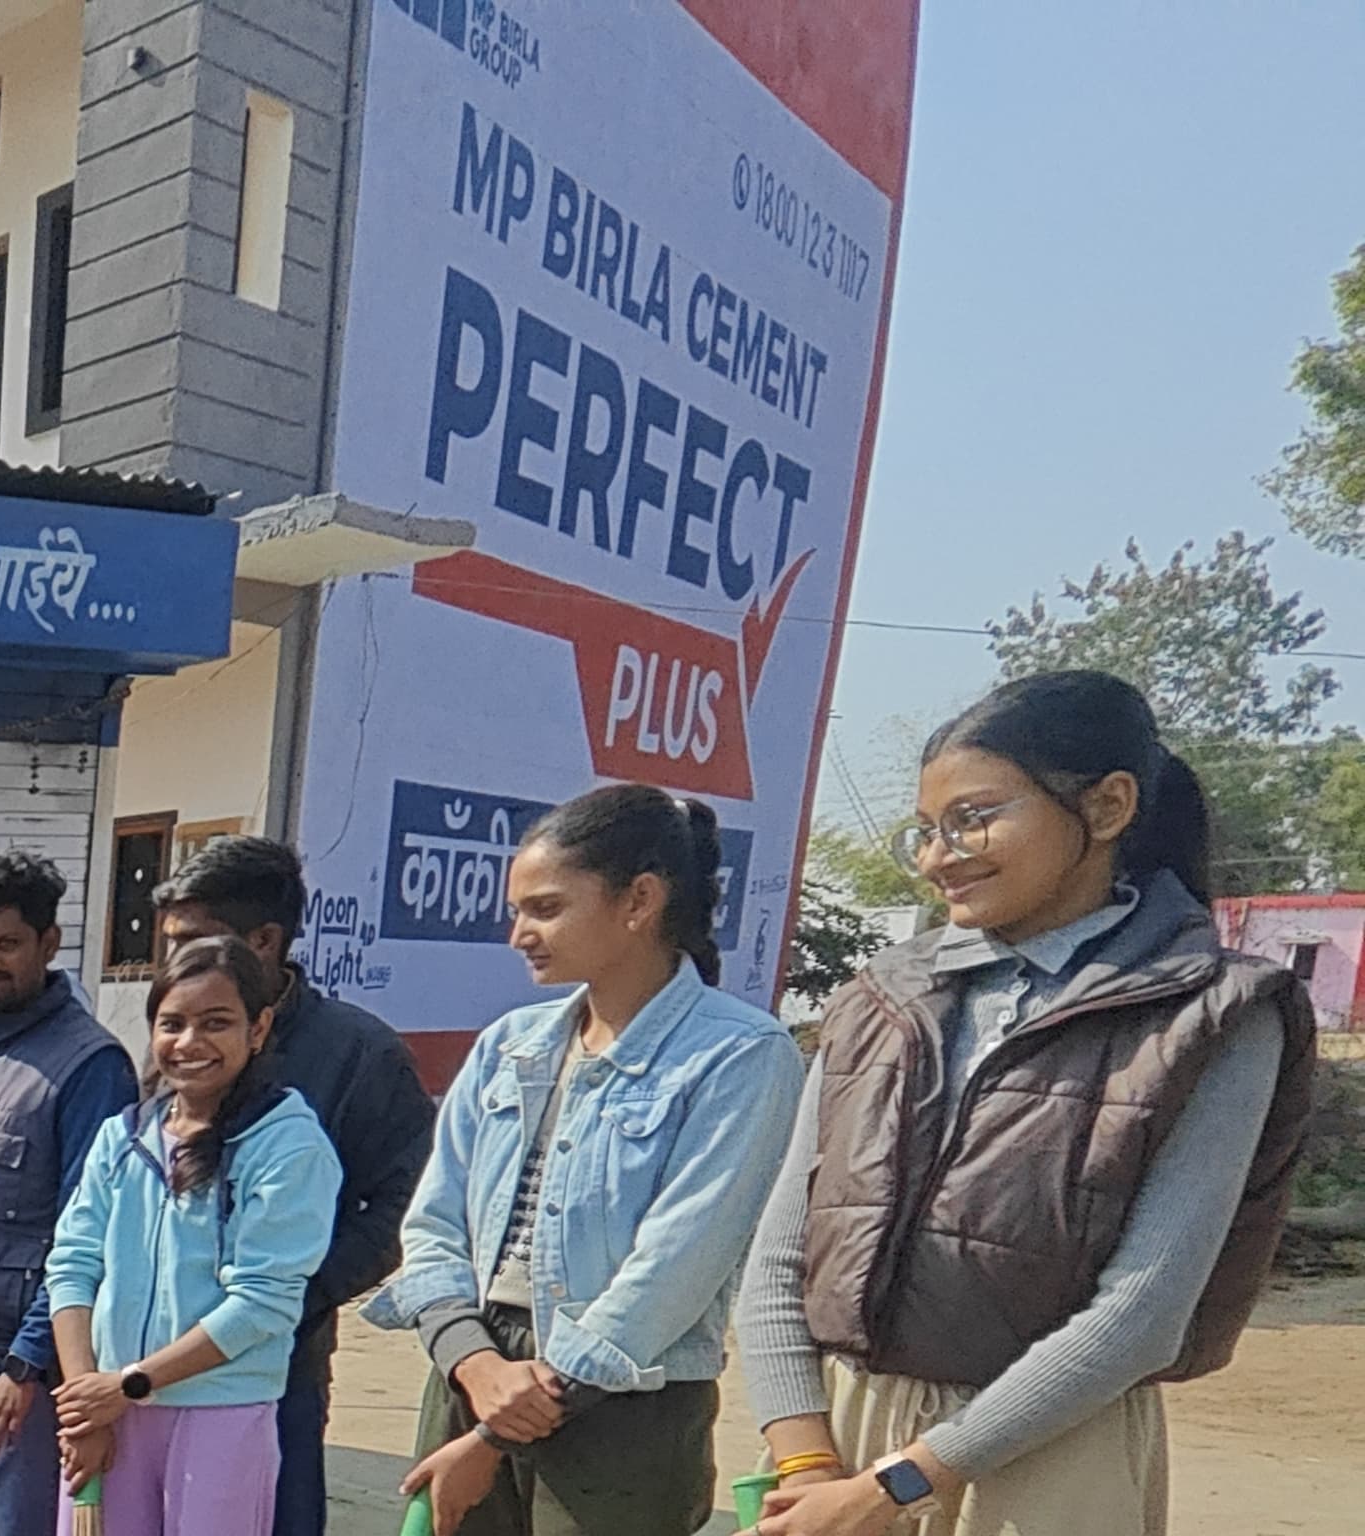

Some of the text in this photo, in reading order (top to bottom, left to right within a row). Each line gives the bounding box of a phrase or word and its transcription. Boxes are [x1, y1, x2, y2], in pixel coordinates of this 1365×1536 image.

[470, 27, 522, 90] GROUP
[500, 10, 540, 73] BIRLA
[755, 162, 798, 247] 1800
[453, 101, 829, 429] MP BIRLA CEMENT
[425, 264, 812, 601] PERFECT
[604, 644, 723, 763] PLUS
